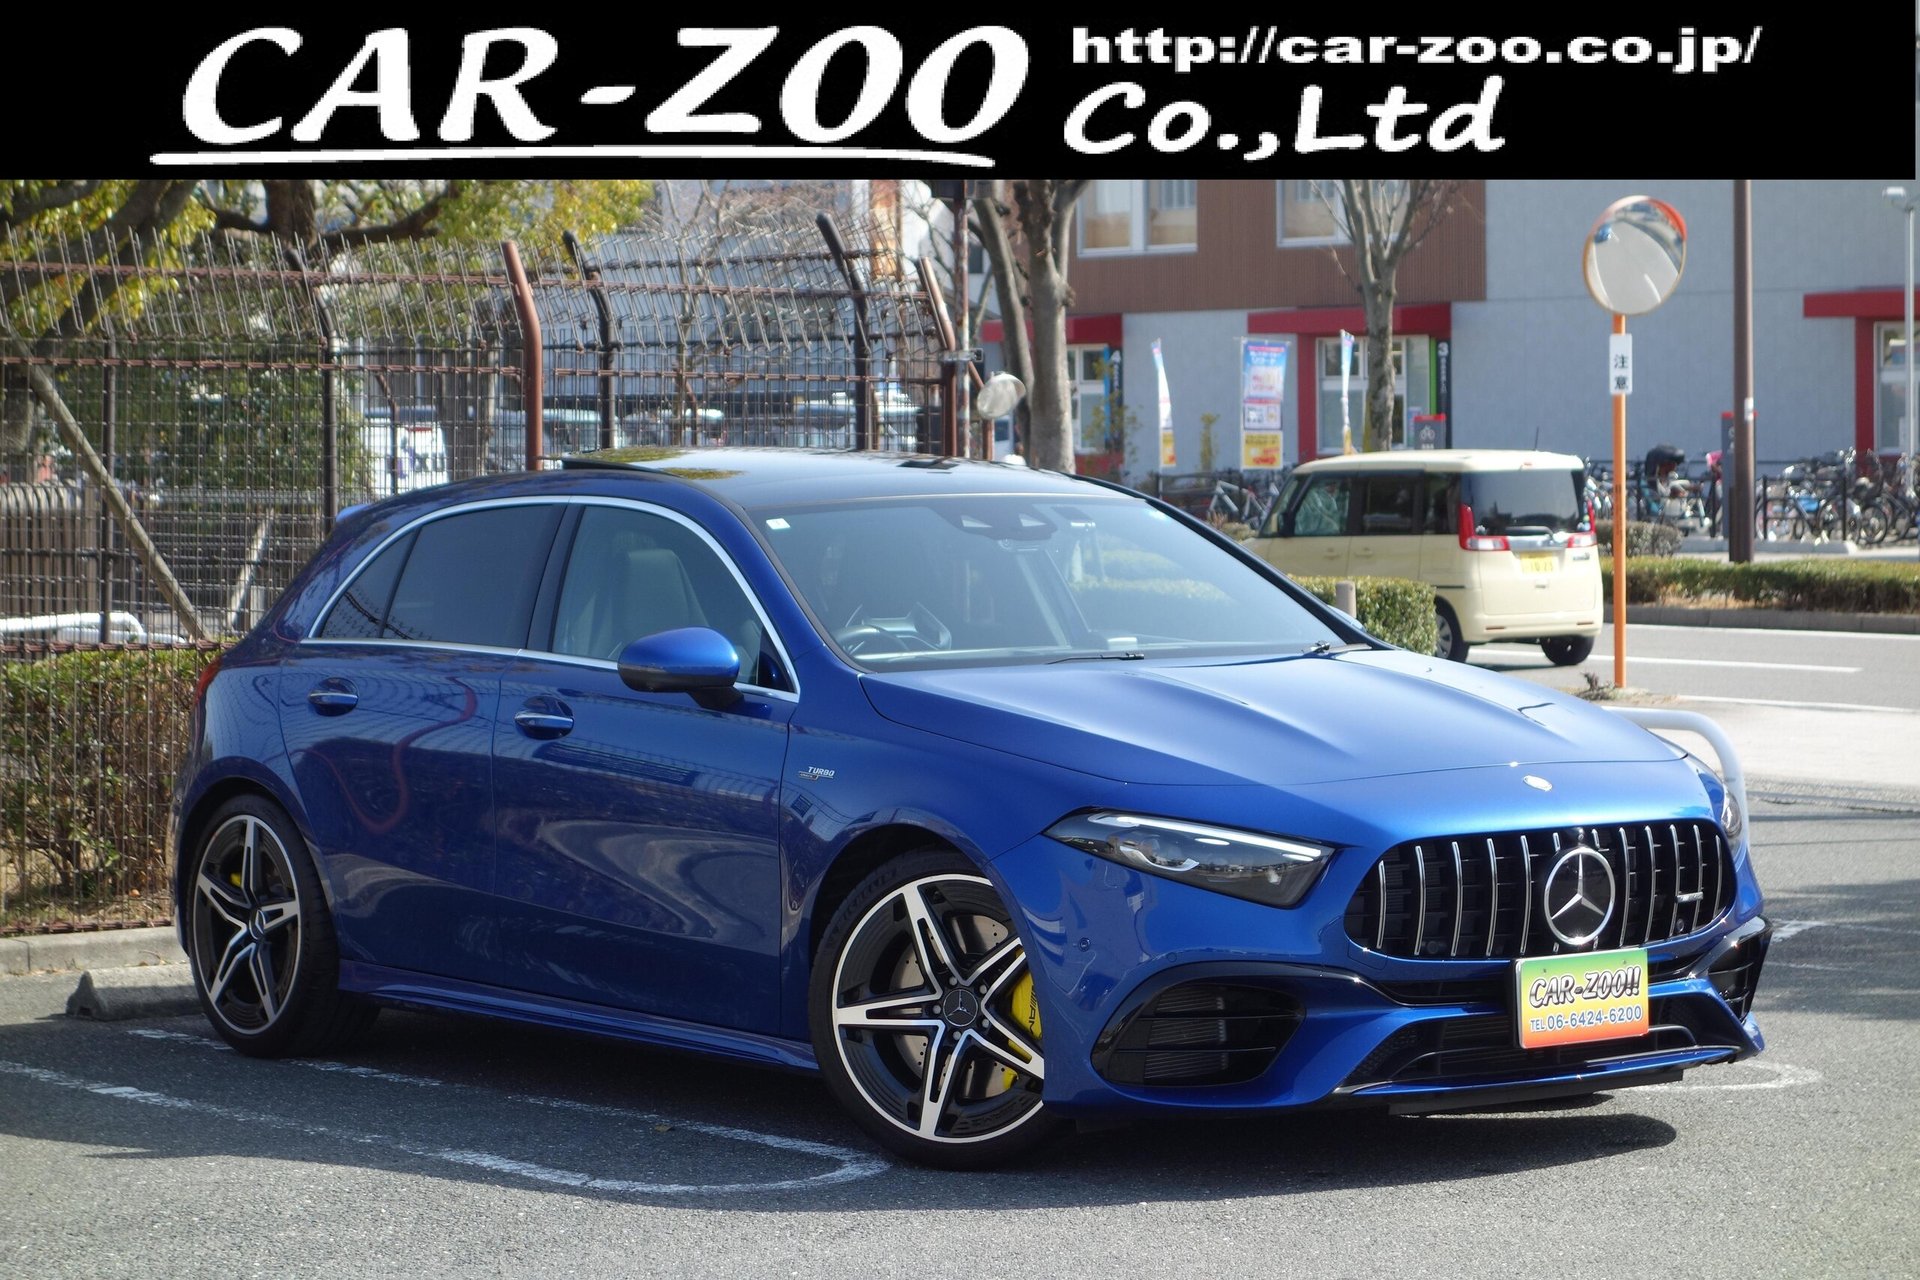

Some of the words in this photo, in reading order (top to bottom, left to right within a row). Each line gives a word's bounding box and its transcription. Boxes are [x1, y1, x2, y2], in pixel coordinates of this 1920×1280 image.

[808, 766, 835, 777] TURBO
[1529, 966, 1641, 1009] CAR-ZOO!!
[1531, 1018, 1545, 1031] TEL
[1547, 1005, 1642, 1030] 06-6424-6200
